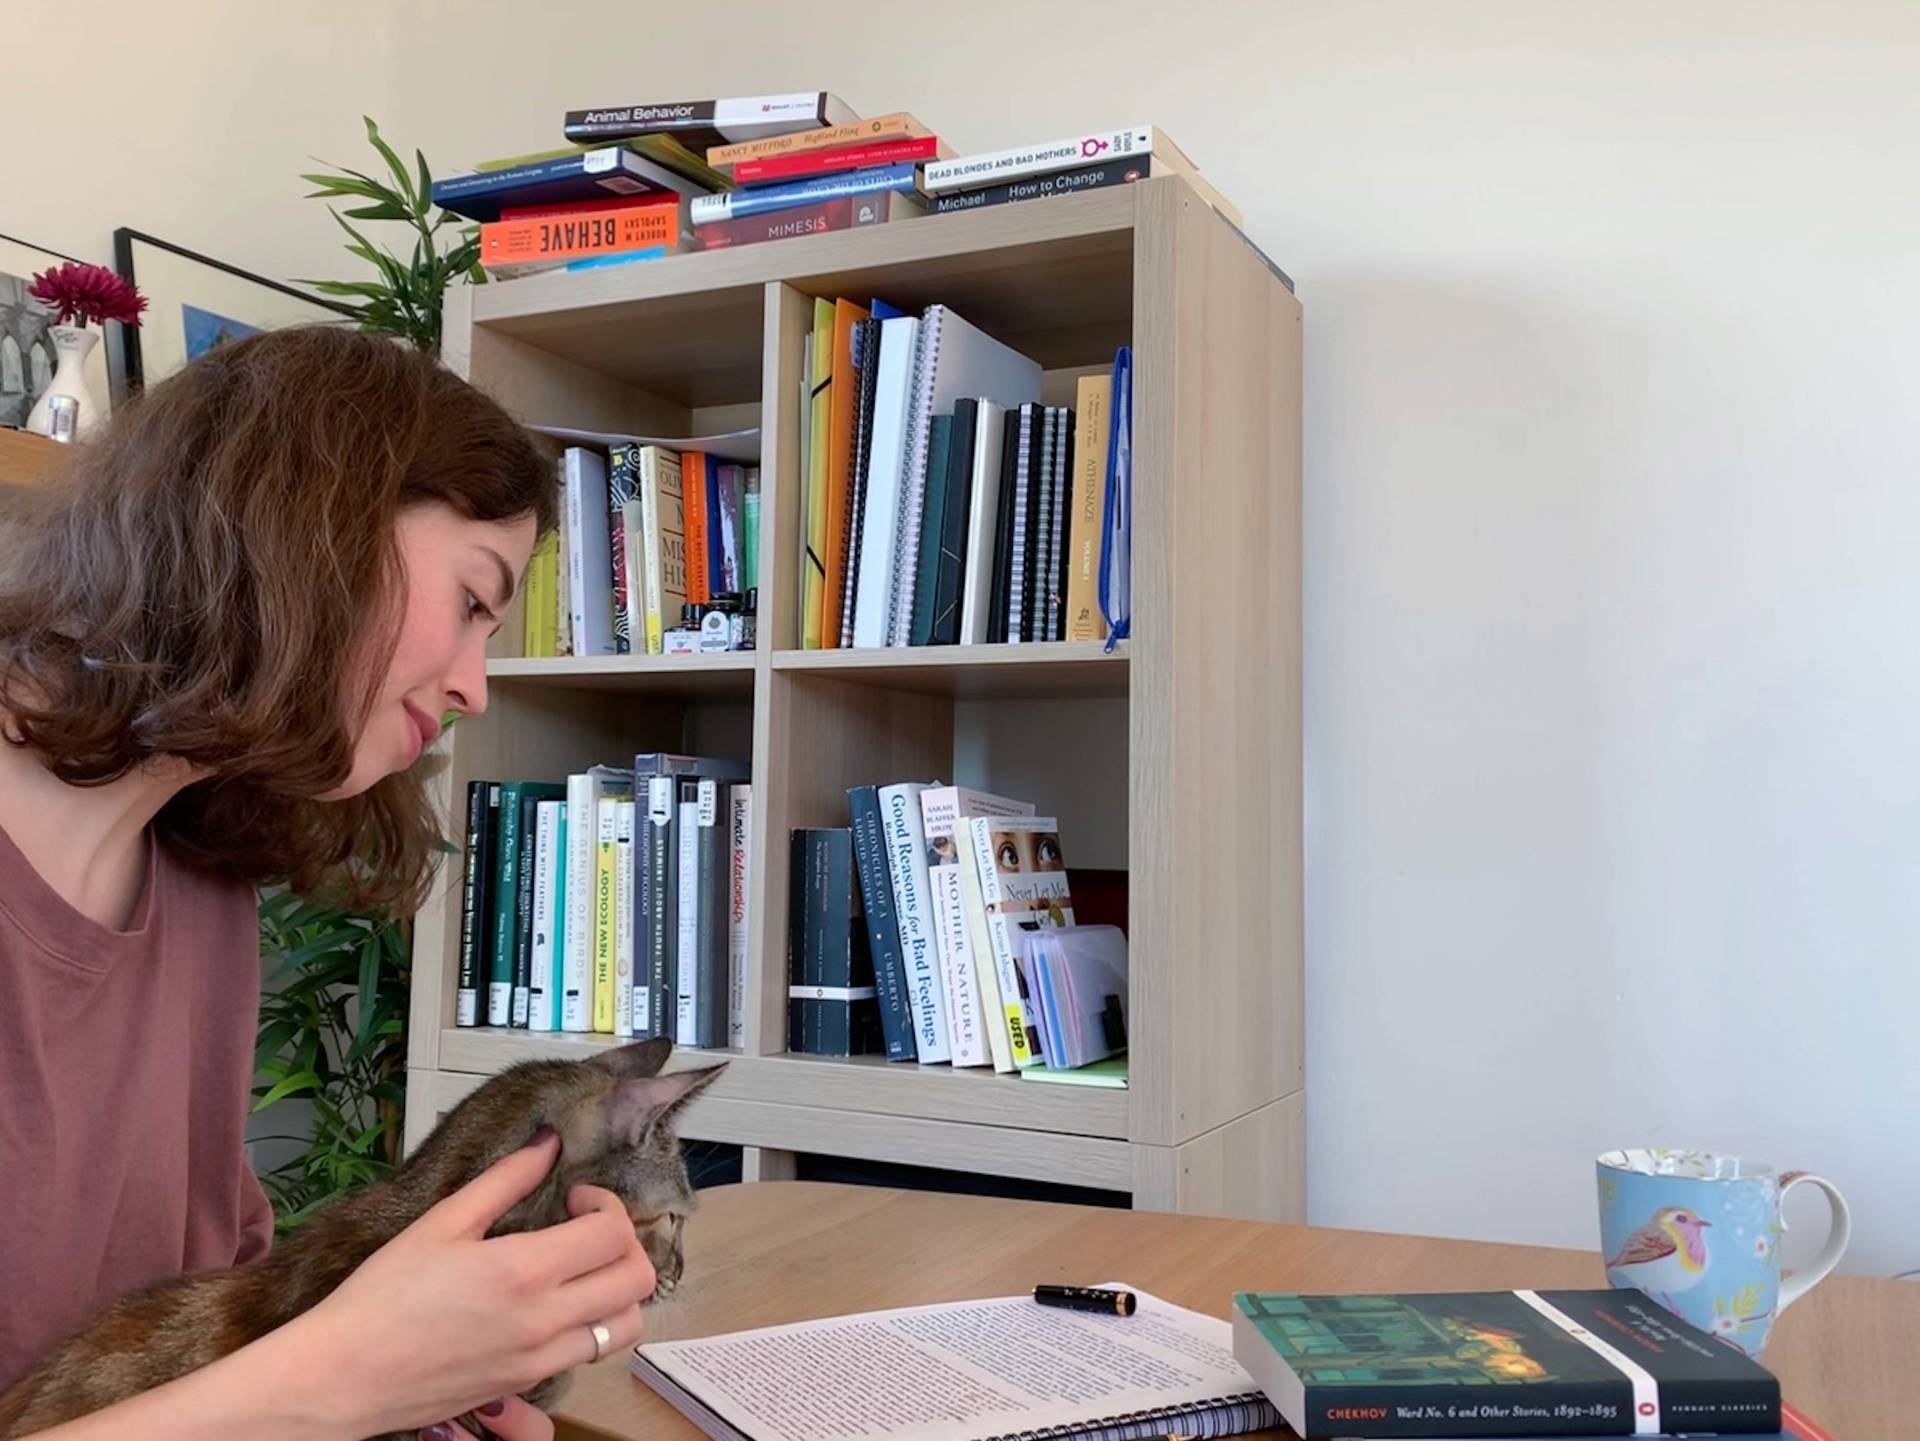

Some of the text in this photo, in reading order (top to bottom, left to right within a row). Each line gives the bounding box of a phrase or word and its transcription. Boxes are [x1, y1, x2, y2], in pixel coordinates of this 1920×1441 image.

[584, 105, 694, 124] Animal Behavior
[928, 147, 1077, 181] DEAD BLONDES AND BAD MOTHERS
[1008, 181, 1037, 198] How
[1040, 179, 1053, 192] to
[1056, 170, 1105, 189] Change
[624, 215, 667, 228] SAPOLSKY
[767, 216, 827, 238] MIMESIS
[937, 193, 986, 212] Michael
[540, 218, 616, 252] BEHAVE
[634, 228, 667, 241] ROBERT
[1084, 459, 1097, 523] ATHENAZE
[642, 815, 651, 868] PHILOSOPHY
[732, 799, 748, 925] Intimate Relationships
[855, 818, 874, 915] LIQUID SOCIETY
[866, 811, 887, 919] CHRONICLES OF A
[975, 819, 996, 899] Never Let Me Go
[576, 803, 589, 979] THE GENIUS OF BIRDS
[642, 876, 650, 915] ECOLOGY
[655, 839, 664, 980] THE TRUTH ABOUT ANIMALS
[885, 822, 900, 872] Randolph
[900, 926, 910, 945] MD
[1006, 881, 1066, 902] Never Let Me
[599, 868, 609, 984] THE NEW ECOLOGY
[891, 794, 937, 1048] Good Reasons for Bad Feelings
[883, 952, 900, 1012] UMBERTO
[947, 872, 973, 1043] MOTHER NATURE
[994, 921, 1013, 993] Kazuo Ishiguro
[875, 971, 885, 997] ECO
[1010, 1016, 1025, 1049] USED
[1327, 1408, 1388, 1419] CHEKHOV
[1396, 1406, 1423, 1418] Ward
[1425, 1406, 1444, 1418] No.
[1448, 1405, 1456, 1418] 6
[1458, 1405, 1477, 1418] and
[1480, 1405, 1510, 1418] Other
[1512, 1405, 1550, 1418] Stories,
